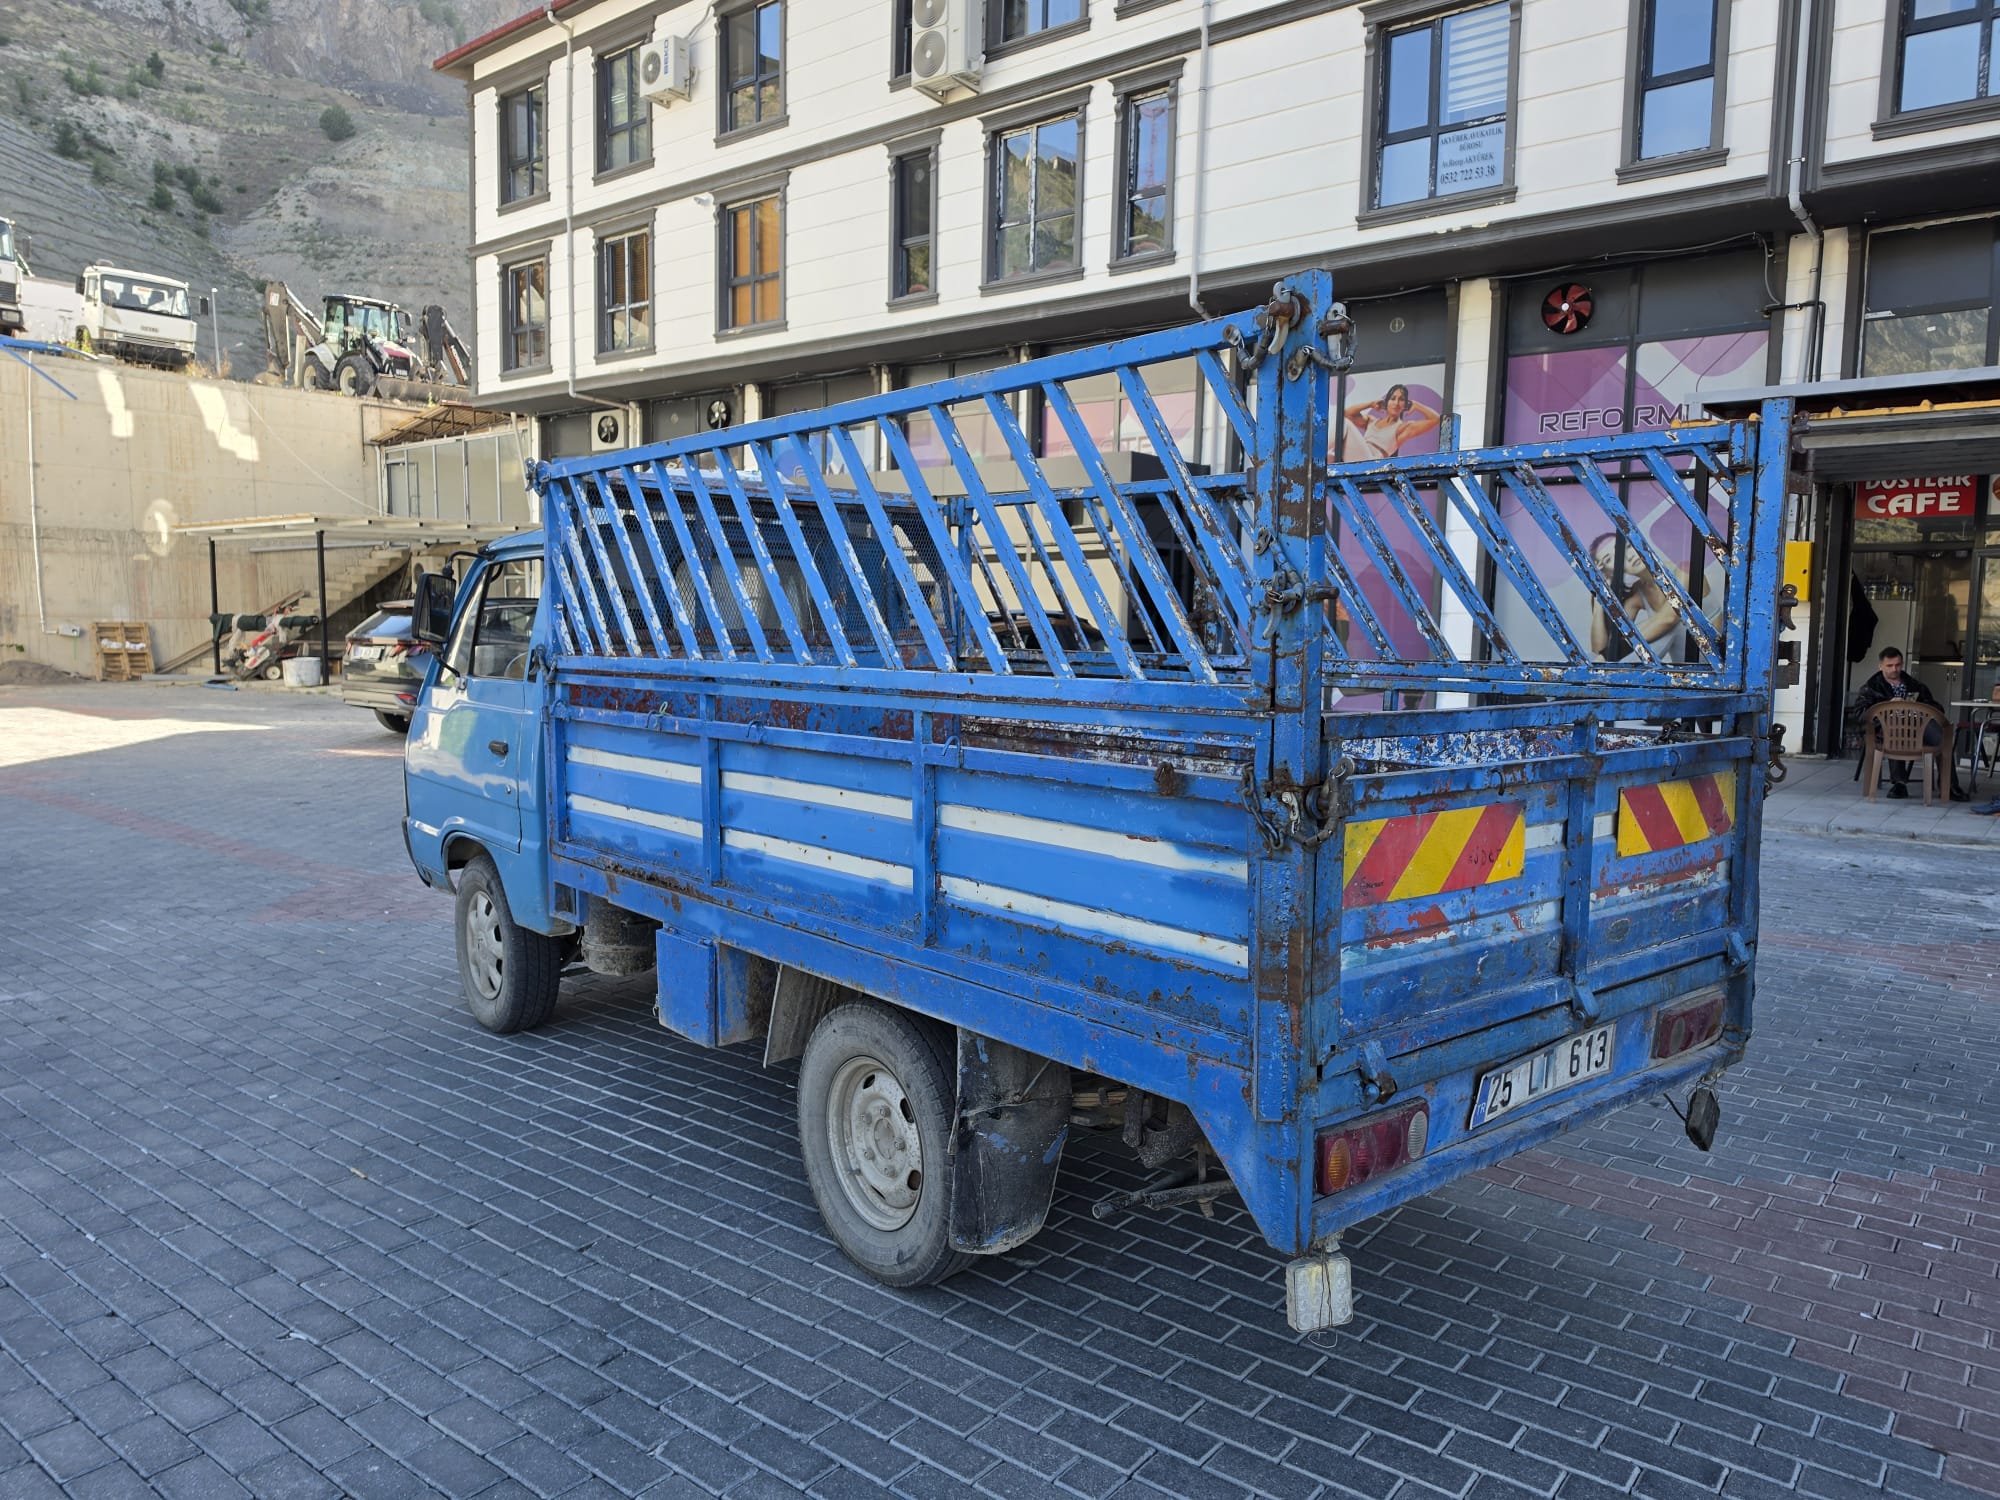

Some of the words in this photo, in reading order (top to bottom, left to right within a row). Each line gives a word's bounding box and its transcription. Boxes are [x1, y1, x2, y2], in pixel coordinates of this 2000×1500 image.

[1475, 166, 1484, 178] 53
[1867, 491, 1961, 516] CAFE
[1487, 1073, 1512, 1115] 25
[1569, 1030, 1608, 1078] 613
[1477, 1102, 1486, 1114] TR
